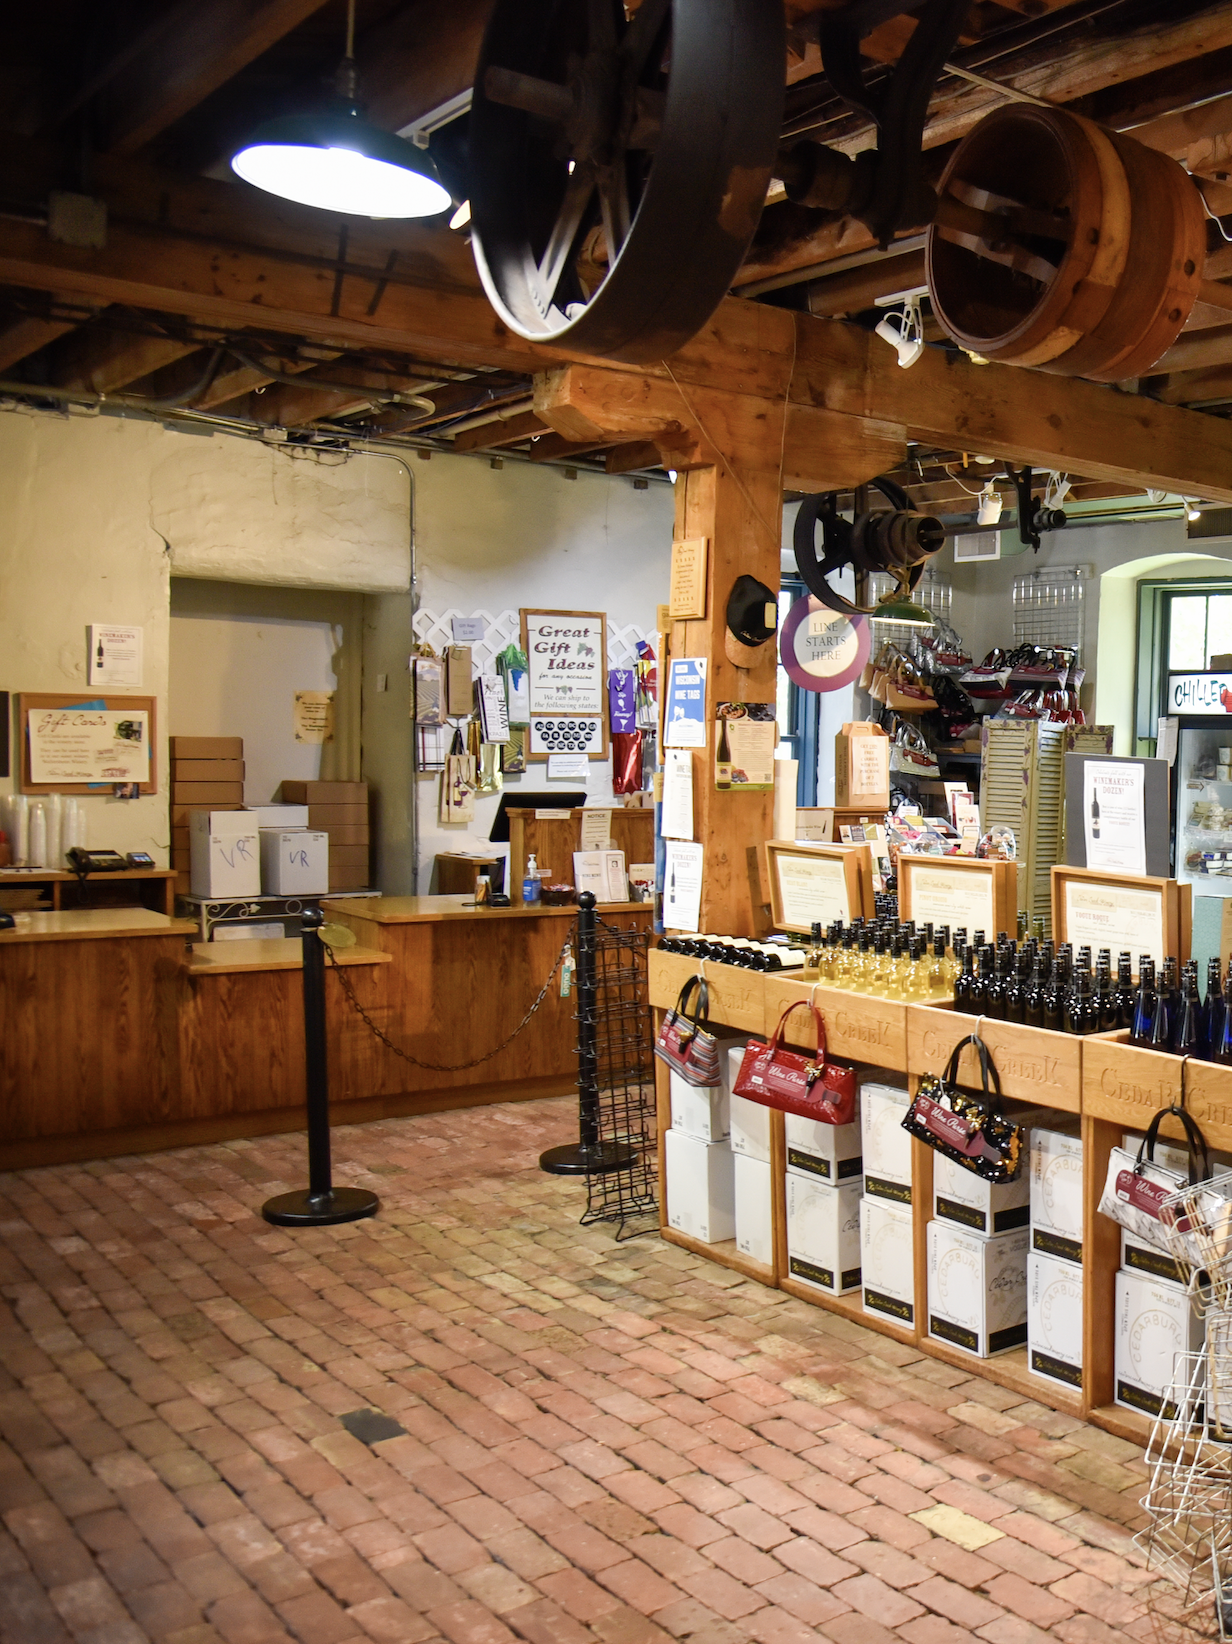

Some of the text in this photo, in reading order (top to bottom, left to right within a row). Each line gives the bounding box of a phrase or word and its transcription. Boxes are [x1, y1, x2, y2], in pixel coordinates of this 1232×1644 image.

[538, 625, 590, 638] Great
[813, 622, 838, 633] LINE
[534, 641, 571, 657] Gift
[805, 636, 847, 647] STARTS
[547, 658, 595, 670] Ideas
[811, 650, 841, 661] HERE
[567, 694, 582, 702] ship
[1174, 678, 1227, 707] CHILLED
[497, 696, 508, 729] WINE
[545, 702, 577, 710] following
[1093, 776, 1135, 787] WINEMAKER'S
[1103, 786, 1125, 795] DOZEN!
[220, 839, 255, 868] VR
[289, 849, 310, 868] VR
[835, 1011, 893, 1048] CREEK
[768, 1065, 807, 1086] Wine Purse
[1100, 1067, 1176, 1111] CEDAR
[930, 1106, 967, 1135] Wine Purse
[1045, 1159, 1083, 1209] CEDARBU
[1135, 1180, 1155, 1198] Wine
[1043, 1284, 1083, 1332] CEDARBUR
